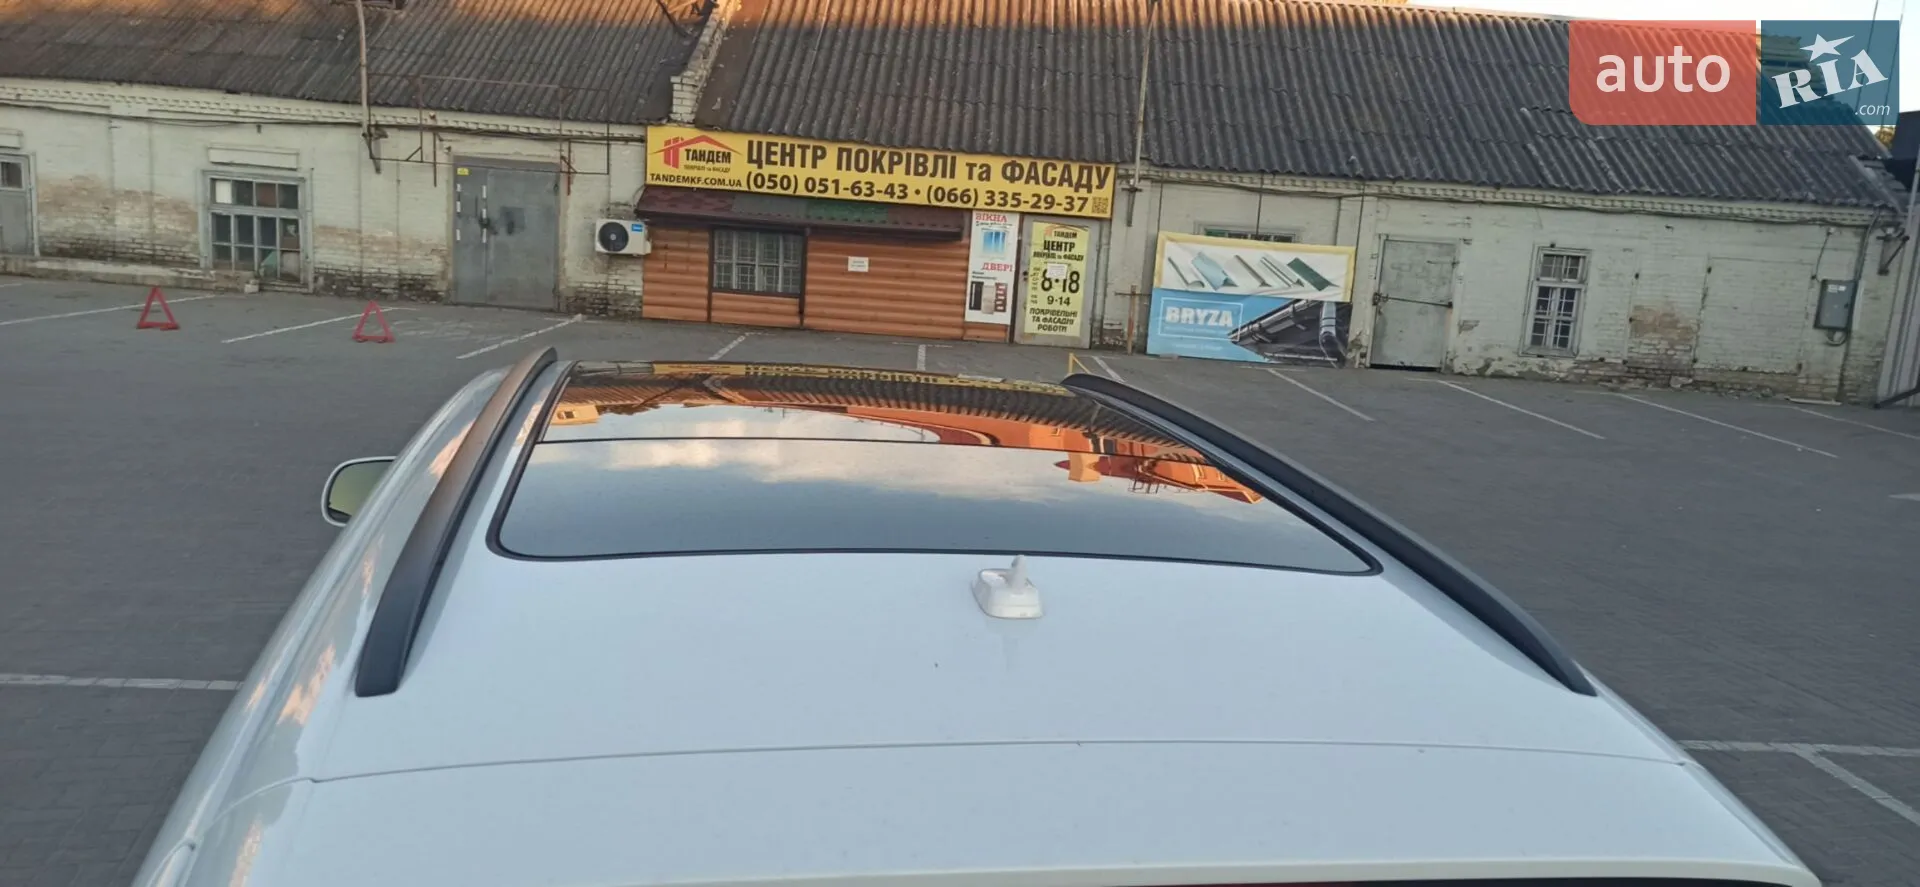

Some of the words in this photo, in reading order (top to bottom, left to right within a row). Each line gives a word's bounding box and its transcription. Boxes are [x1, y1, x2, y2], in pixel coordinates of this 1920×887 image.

[684, 148, 732, 165] ТАНДЕМ
[746, 139, 827, 170] ЦЕНТР
[836, 146, 957, 180] ПОКРІВЛІ
[966, 162, 992, 182] та
[1001, 160, 1111, 194] ФАСАДУ
[650, 173, 742, 188] TANDEMKF.COM.UA
[746, 171, 798, 194] (050)
[804, 176, 909, 200] 051-63-43
[926, 185, 979, 207] (066)
[984, 190, 1089, 212] 335-29-37
[1043, 240, 1076, 252] ЦЕНТР
[982, 262, 1013, 272] ДВЕРІ
[1165, 306, 1233, 327] BRYZA
[1037, 324, 1067, 332] РОБОТИ
